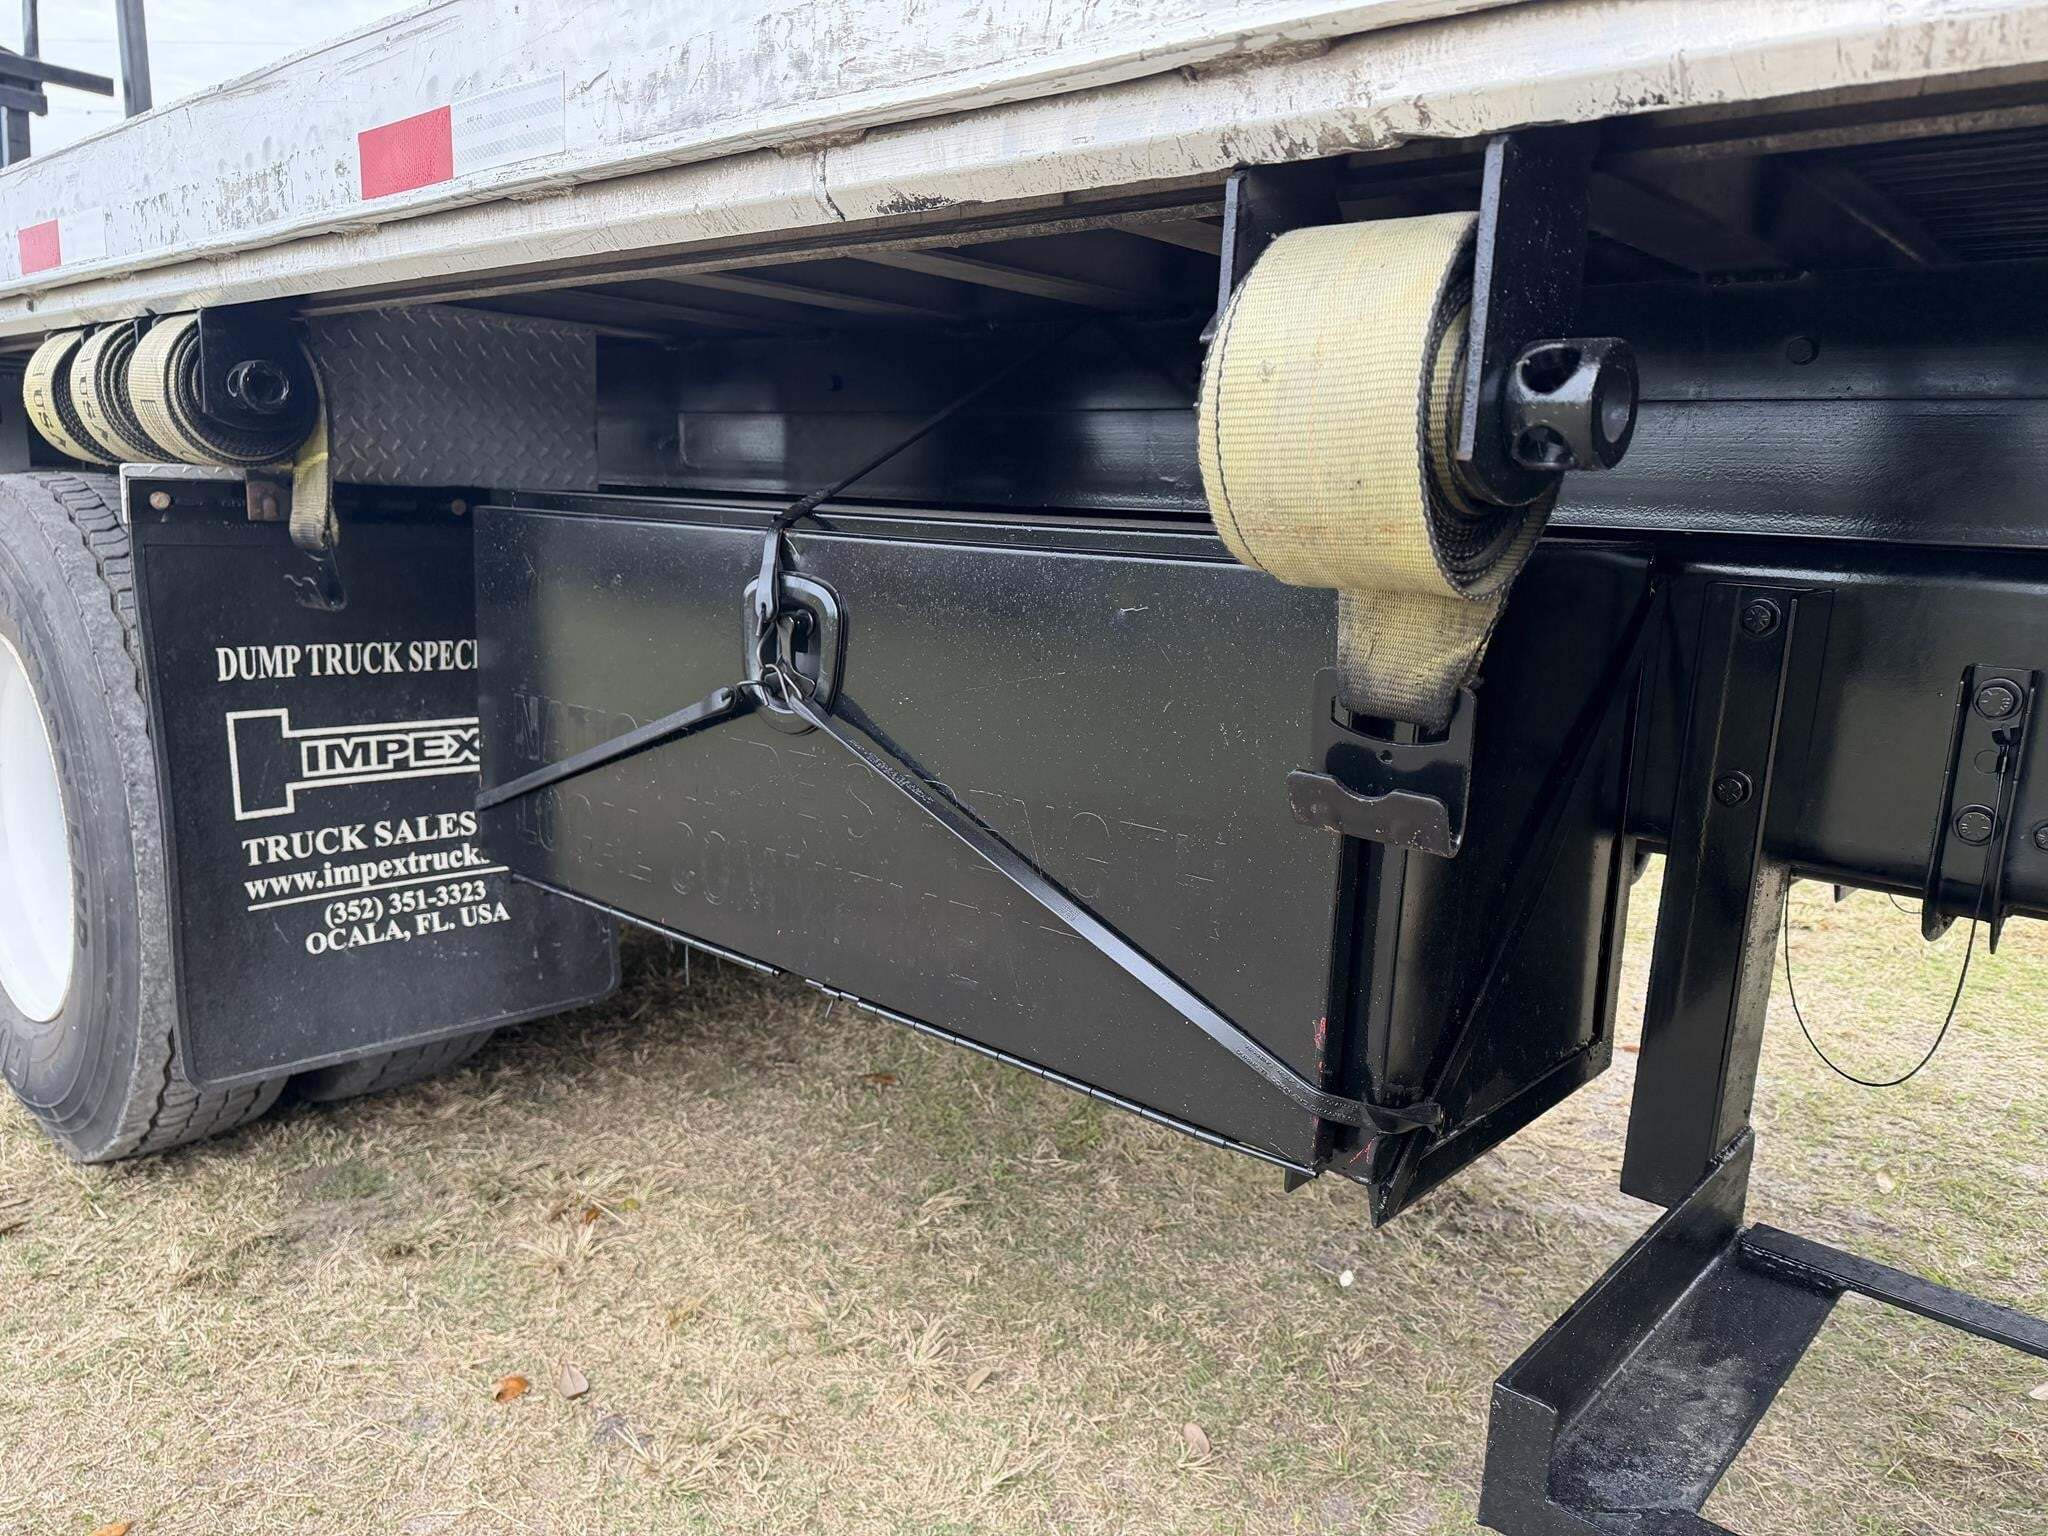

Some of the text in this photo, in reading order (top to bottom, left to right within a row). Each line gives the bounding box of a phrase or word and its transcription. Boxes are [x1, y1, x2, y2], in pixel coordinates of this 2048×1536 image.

[216, 645, 301, 681] DUMP
[306, 642, 404, 676] TRUCK
[301, 727, 480, 778] IMPEX
[242, 810, 479, 867] TRUCK SALES
[244, 841, 491, 900] www.impextruck
[305, 902, 511, 955] OCALA, FL. USA
[325, 881, 487, 928] (352) 351-3323
